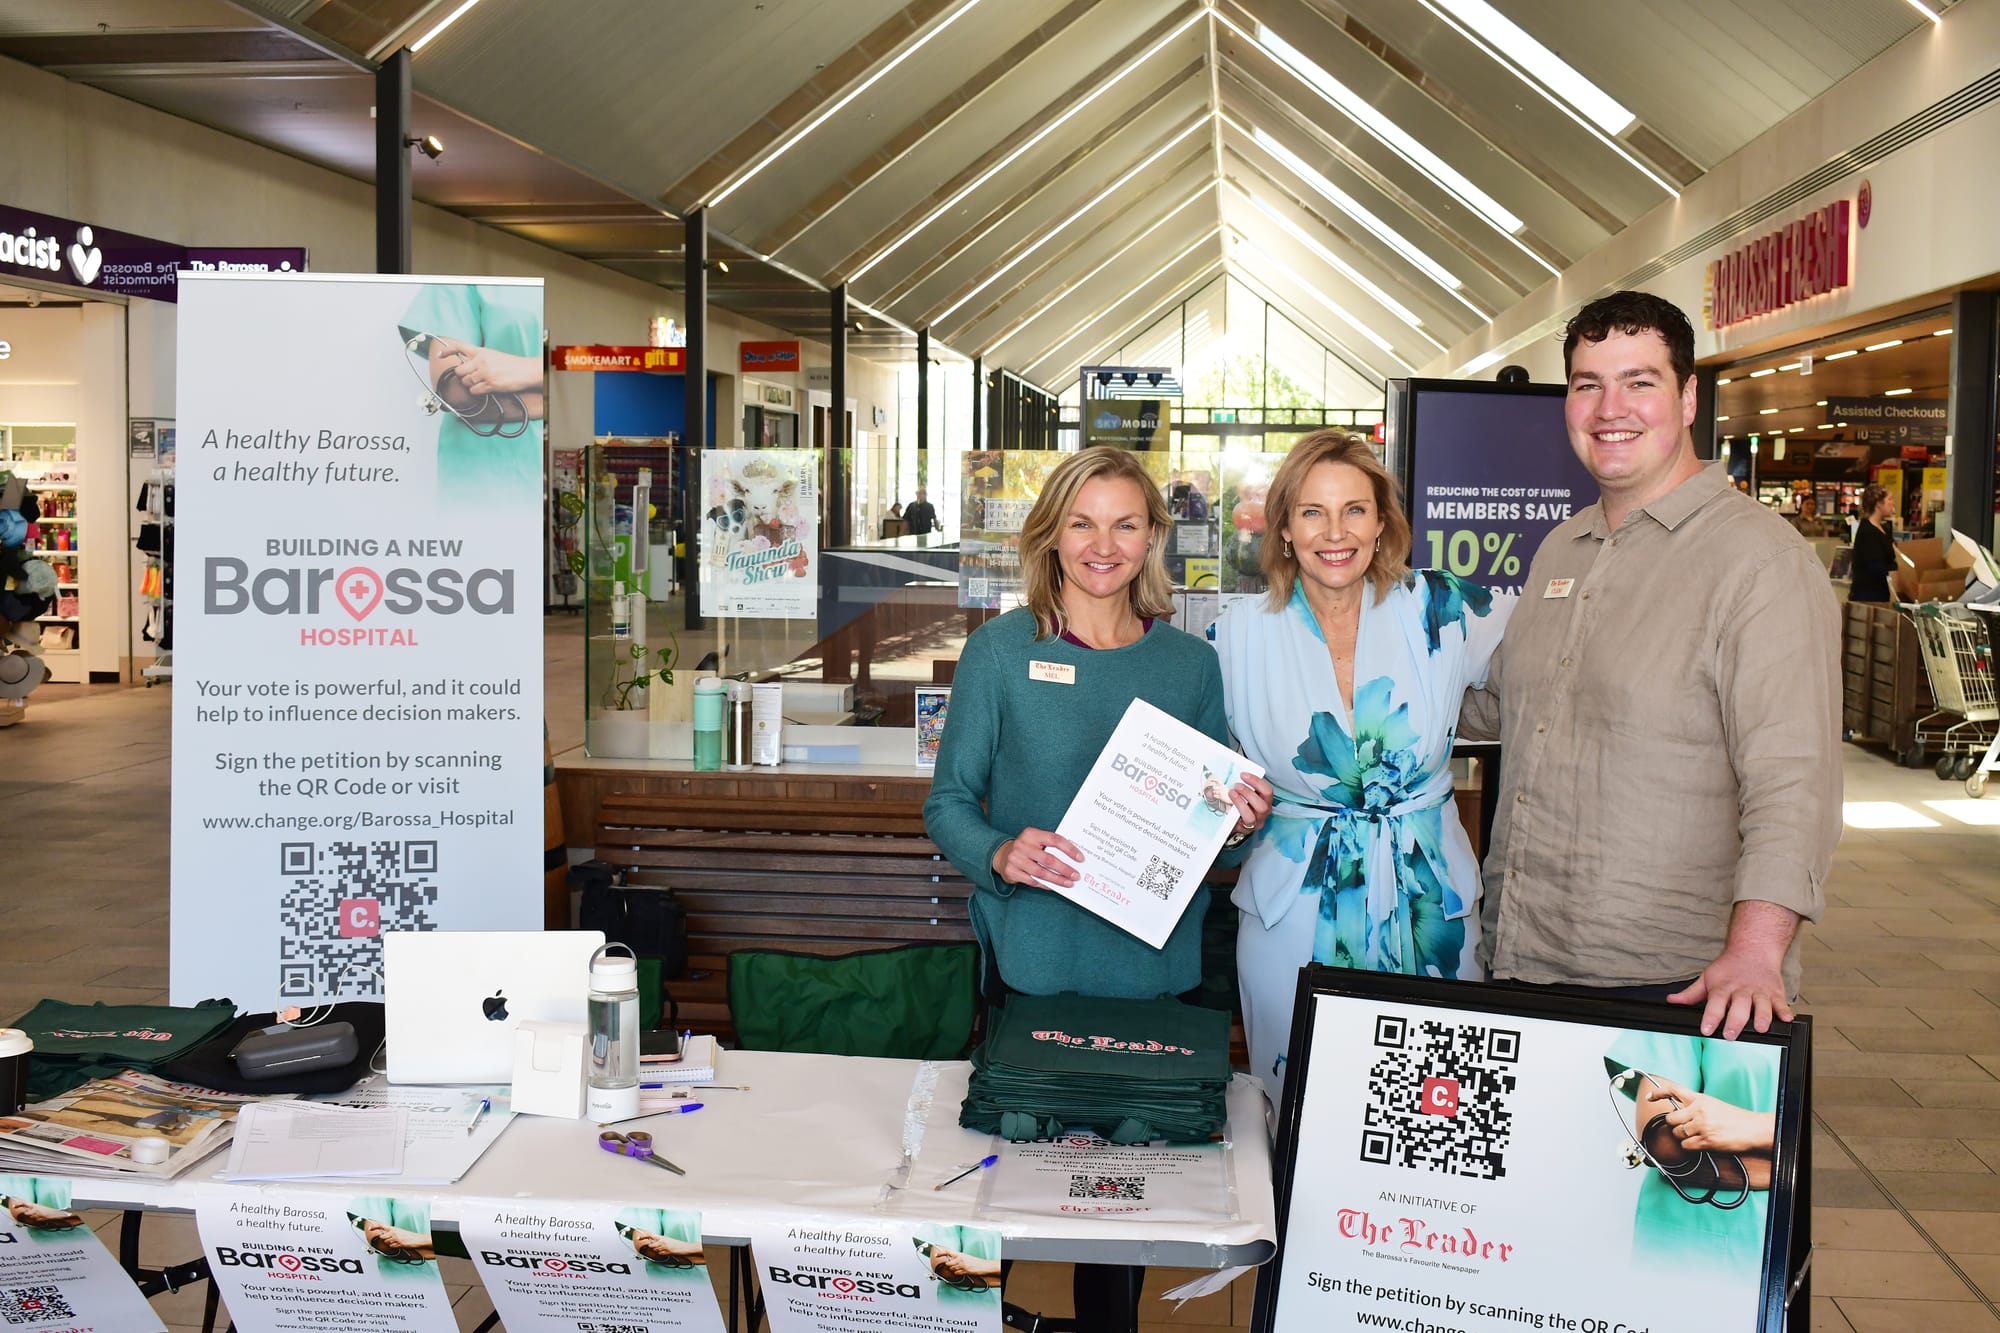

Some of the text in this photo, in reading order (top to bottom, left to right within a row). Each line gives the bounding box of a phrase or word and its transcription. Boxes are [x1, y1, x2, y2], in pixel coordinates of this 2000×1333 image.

[1711, 231, 1785, 330] BAROSSA
[1782, 200, 1850, 306] FRESH
[564, 356, 632, 366] SMOKEMART
[1833, 405, 1946, 419] Assisted Checkouts
[1097, 420, 1163, 429] SKY MOBILE
[202, 429, 411, 453] A healthy Barossa,
[213, 461, 400, 485] a healthy future.
[1427, 487, 1571, 498] REDUCING THE COST OF LIVING
[989, 502, 1033, 510] BAROSS
[1427, 502, 1572, 520] MEMBERS SAVE
[266, 539, 463, 557] BUILDING A NEW
[725, 539, 800, 572] Tanunda
[743, 562, 789, 585] Show
[204, 557, 515, 622] Barossa
[300, 628, 418, 646] HOSPITAL
[196, 679, 521, 699] Your vote is powerful, and it could
[197, 705, 521, 725] help to influence decision makers.
[215, 751, 502, 773] Sign the petition by scanning
[1133, 757, 1164, 777] BUILDING
[1168, 777, 1184, 788] NEW
[258, 777, 460, 798] the QR Code or visit
[1111, 753, 1193, 810] Barossa
[1129, 784, 1160, 805] HOSPITAL
[202, 810, 514, 831] www.change.org/Barossa_Hospital
[1094, 799, 1191, 859] help to influence decision makers.
[1098, 791, 1113, 803] Your
[1113, 800, 1128, 812] vote
[1132, 811, 1161, 833] powerful,
[1162, 828, 1175, 839] and
[1174, 833, 1180, 842] it
[1180, 839, 1198, 852] could
[1031, 1030, 1086, 1045] The
[1088, 1036, 1196, 1055] Leader
[230, 1202, 328, 1220] A healthy Barossa,
[1379, 1191, 1477, 1214] AN INITIATIVE OF
[236, 1218, 323, 1233] a healthy future.
[494, 1213, 595, 1231] A healthy Barossa,
[788, 1228, 892, 1247] A healthy Barossa,
[1336, 1208, 1513, 1262] The Leader
[241, 1242, 295, 1252] BUILDING
[308, 1247, 334, 1255] NEW
[507, 1248, 562, 1258] BUILDING
[794, 1244, 886, 1260] a healthy future.
[216, 1246, 364, 1274] Barossa
[480, 1250, 631, 1275] Barossa
[1362, 1250, 1480, 1275] The Barossa's Favourite Newspaper
[267, 1271, 322, 1281] HOSPITAL
[532, 1271, 589, 1280] HOSPITAL
[769, 1265, 921, 1299] Barossa
[797, 1264, 894, 1280] BUILDING A NEW
[817, 1291, 875, 1302] HOSPITAL
[1308, 1271, 1341, 1292] Sign
[1346, 1279, 1373, 1296] the
[1376, 1286, 1441, 1308] petition
[1446, 1294, 1466, 1315] by
[1469, 1302, 1544, 1329] scanning
[1549, 1313, 1577, 1331] the
[1581, 1318, 1609, 1333] QR
